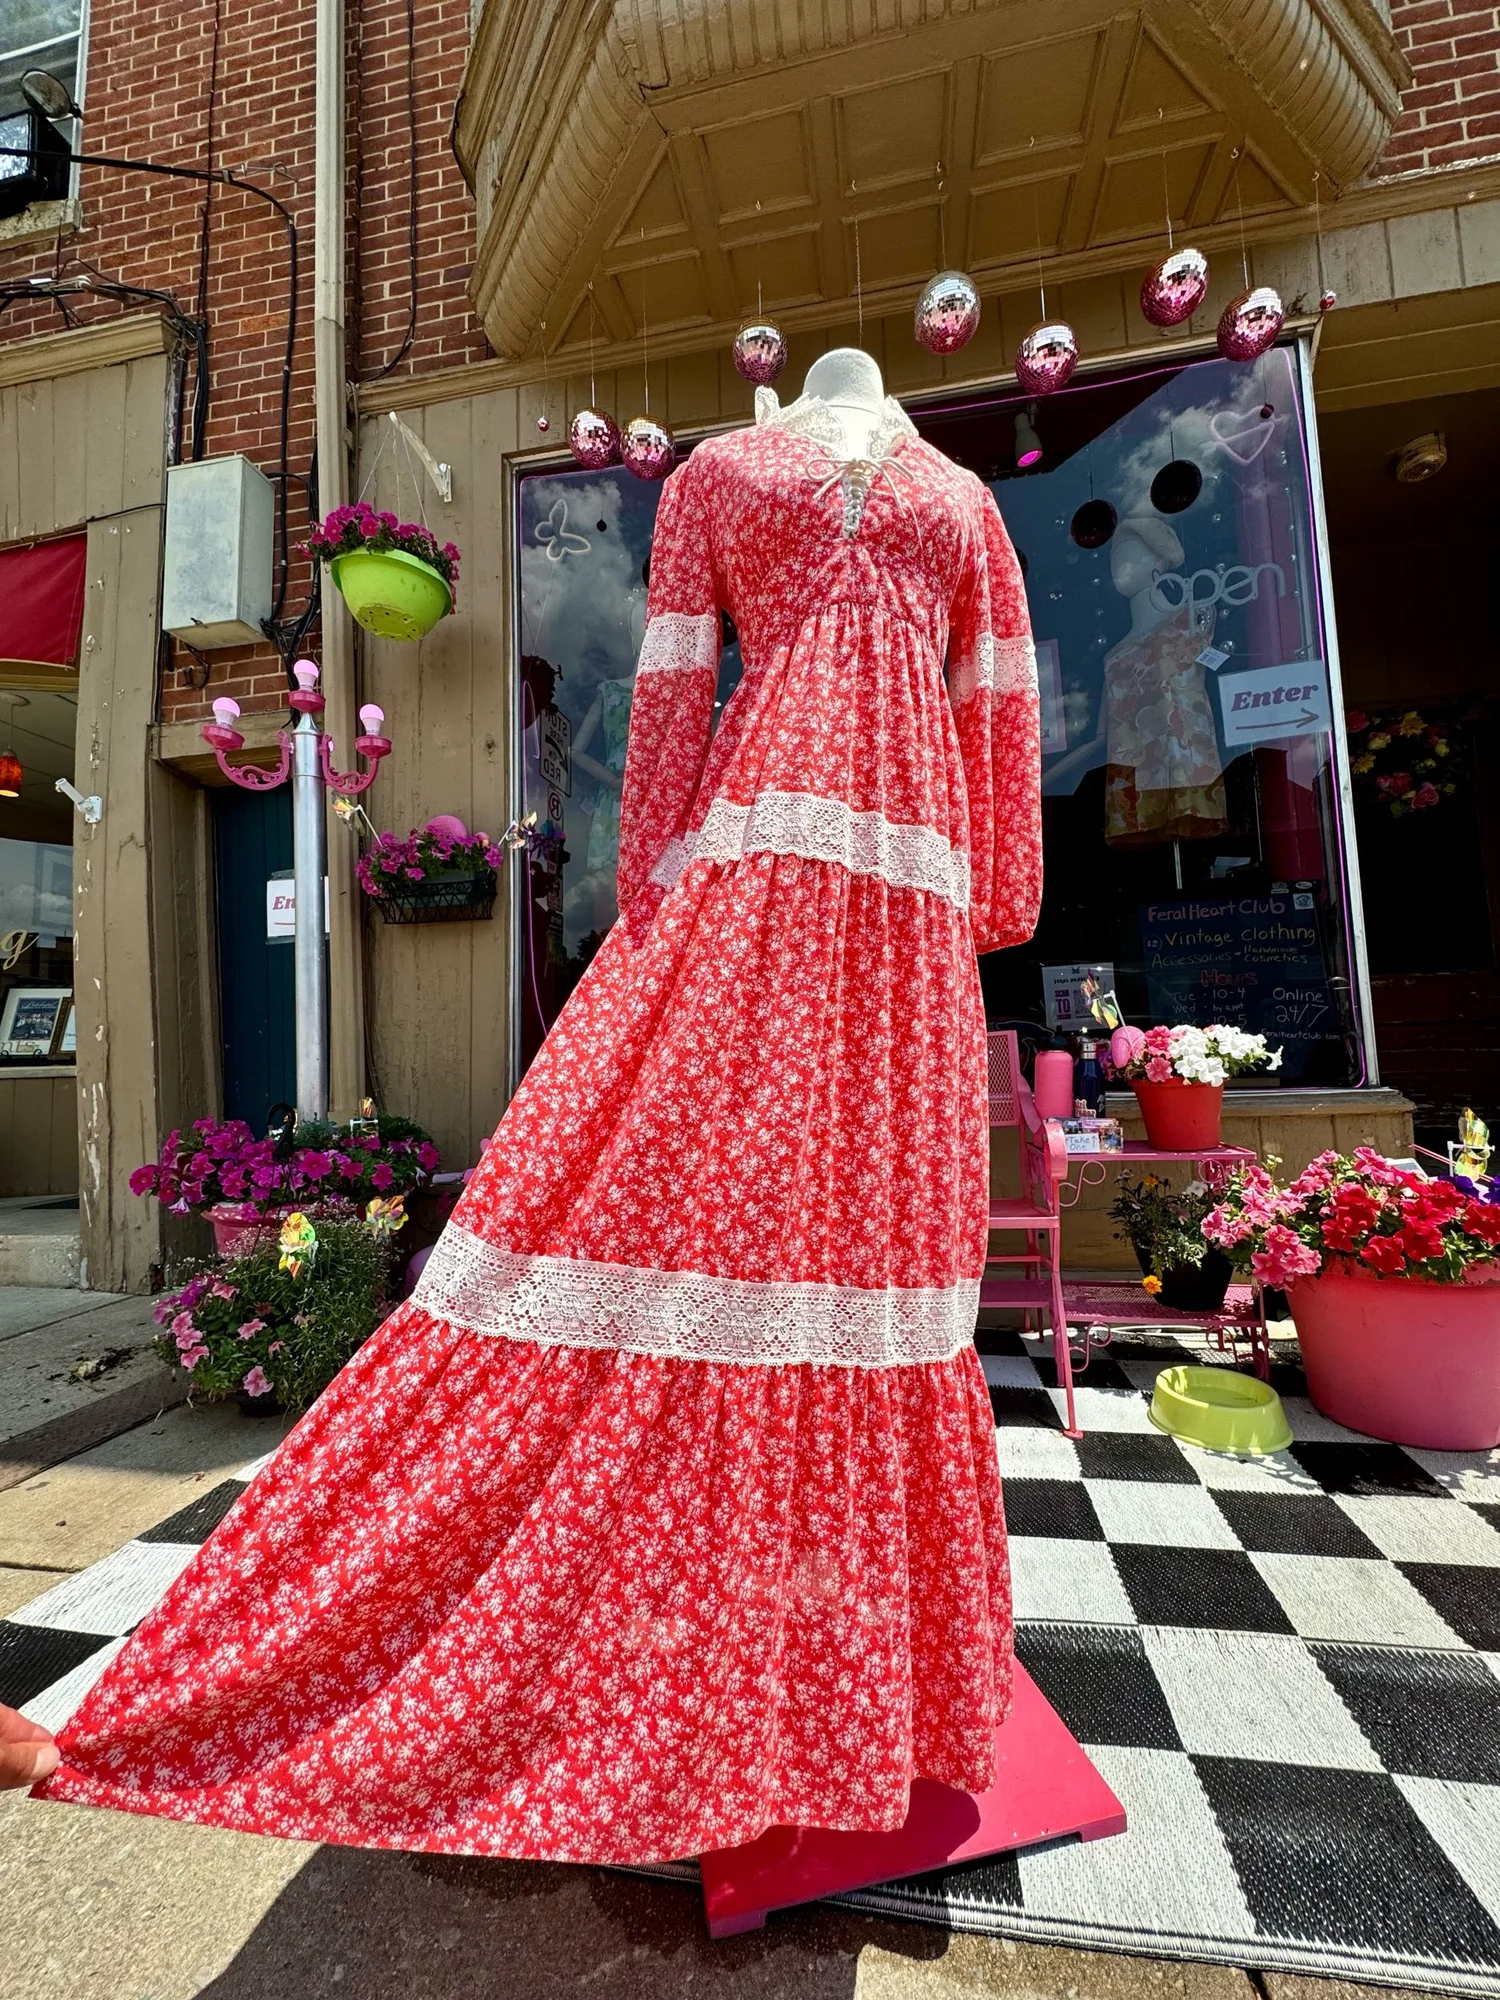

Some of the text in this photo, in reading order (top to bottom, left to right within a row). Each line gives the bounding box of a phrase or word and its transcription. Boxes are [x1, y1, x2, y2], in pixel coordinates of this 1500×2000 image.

[1150, 563, 1285, 637] open
[1231, 684, 1319, 712] Enter
[1147, 904, 1186, 922] Feral
[1189, 900, 1236, 921] Heart
[1239, 898, 1286, 915] Club
[1165, 928, 1234, 947] Vintage
[1241, 922, 1316, 948] Clothing
[1244, 945, 1298, 955] Handmade
[1244, 953, 1308, 963] Cosmetics
[1152, 952, 1233, 969] Accessories
[1200, 969, 1258, 987] Hours
[1170, 991, 1196, 1002] Tue
[1273, 987, 1324, 1003] Online
[1055, 998, 1071, 1014] TO
[1172, 1001, 1196, 1014] Wed
[1275, 1003, 1330, 1028] 24/7
[1068, 1136, 1090, 1144] Take
[1070, 1143, 1088, 1151] One
